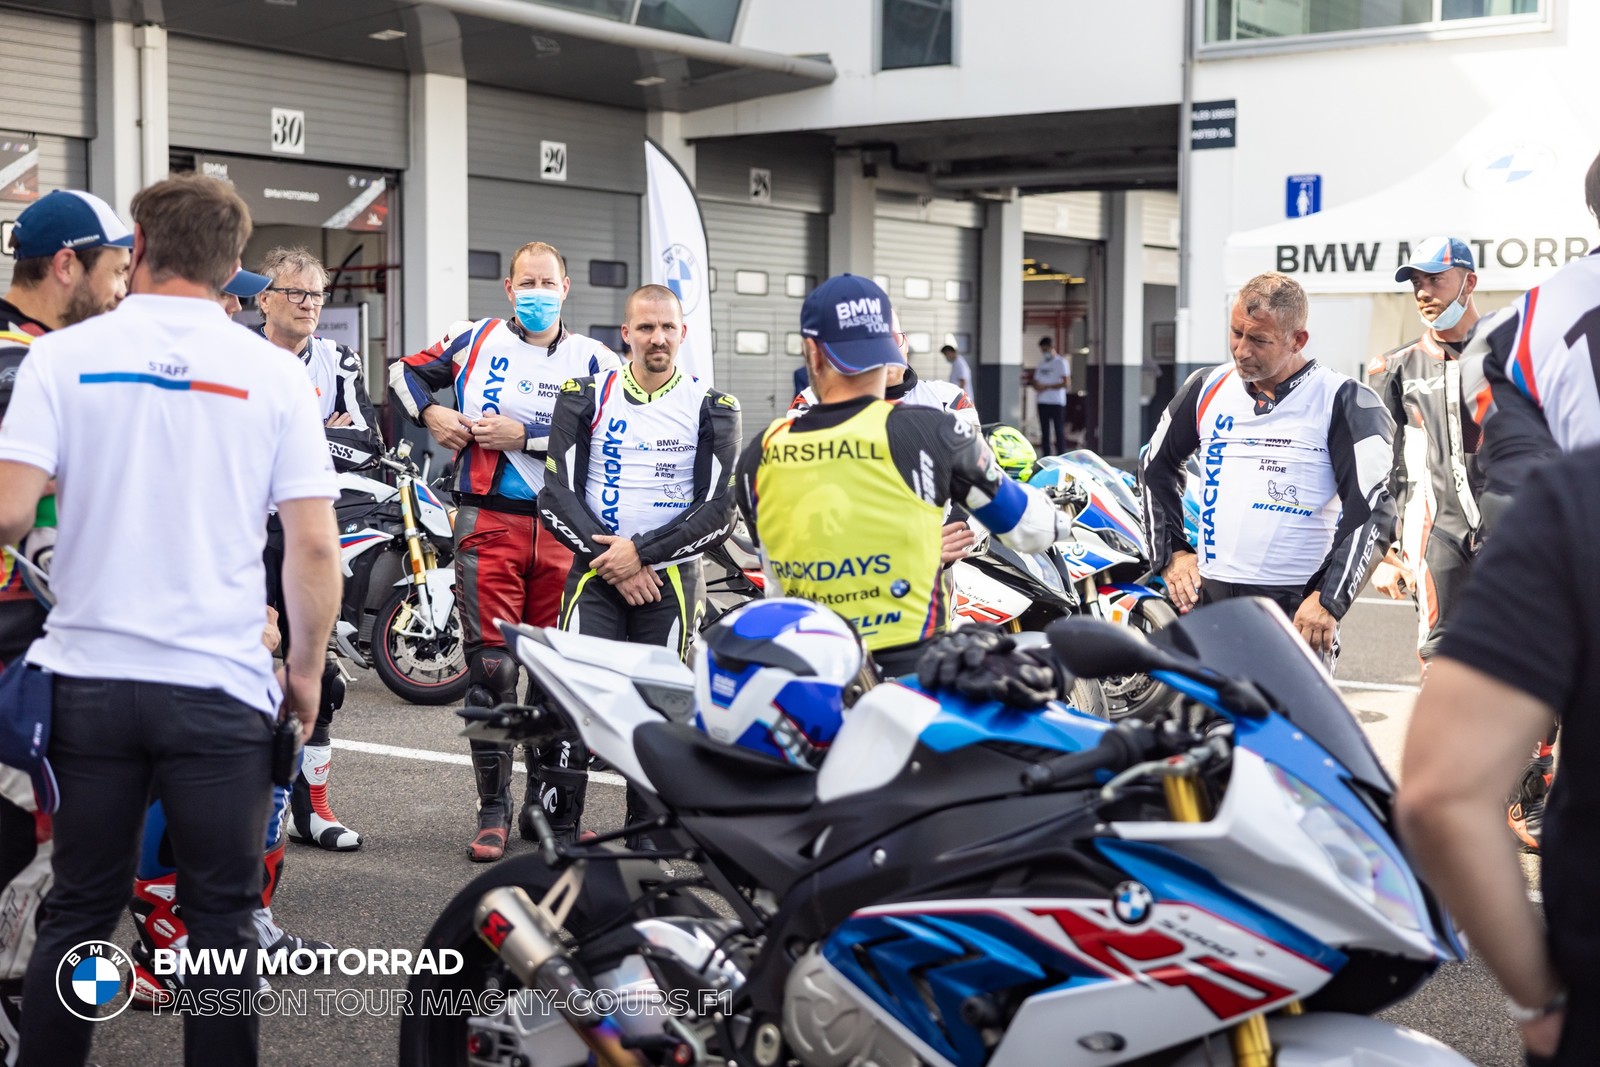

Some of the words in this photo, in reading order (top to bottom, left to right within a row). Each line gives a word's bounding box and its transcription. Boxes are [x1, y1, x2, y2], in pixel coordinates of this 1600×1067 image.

[273, 113, 303, 147] 30
[543, 146, 566, 175] 29
[1276, 242, 1380, 273] BMW
[835, 298, 881, 320] BMW
[839, 314, 884, 330] PASSION
[866, 322, 890, 334] TOUR
[148, 360, 189, 377] STAFF
[538, 382, 562, 392] BMW
[656, 439, 679, 447] BMW
[761, 440, 885, 467] MARSHALL
[655, 462, 677, 470] MAKE
[1266, 465, 1287, 473] RIDE
[1252, 502, 1313, 517] MICHELIN
[769, 554, 891, 582] TRACKDAYS
[1347, 523, 1381, 601] DAINESE
